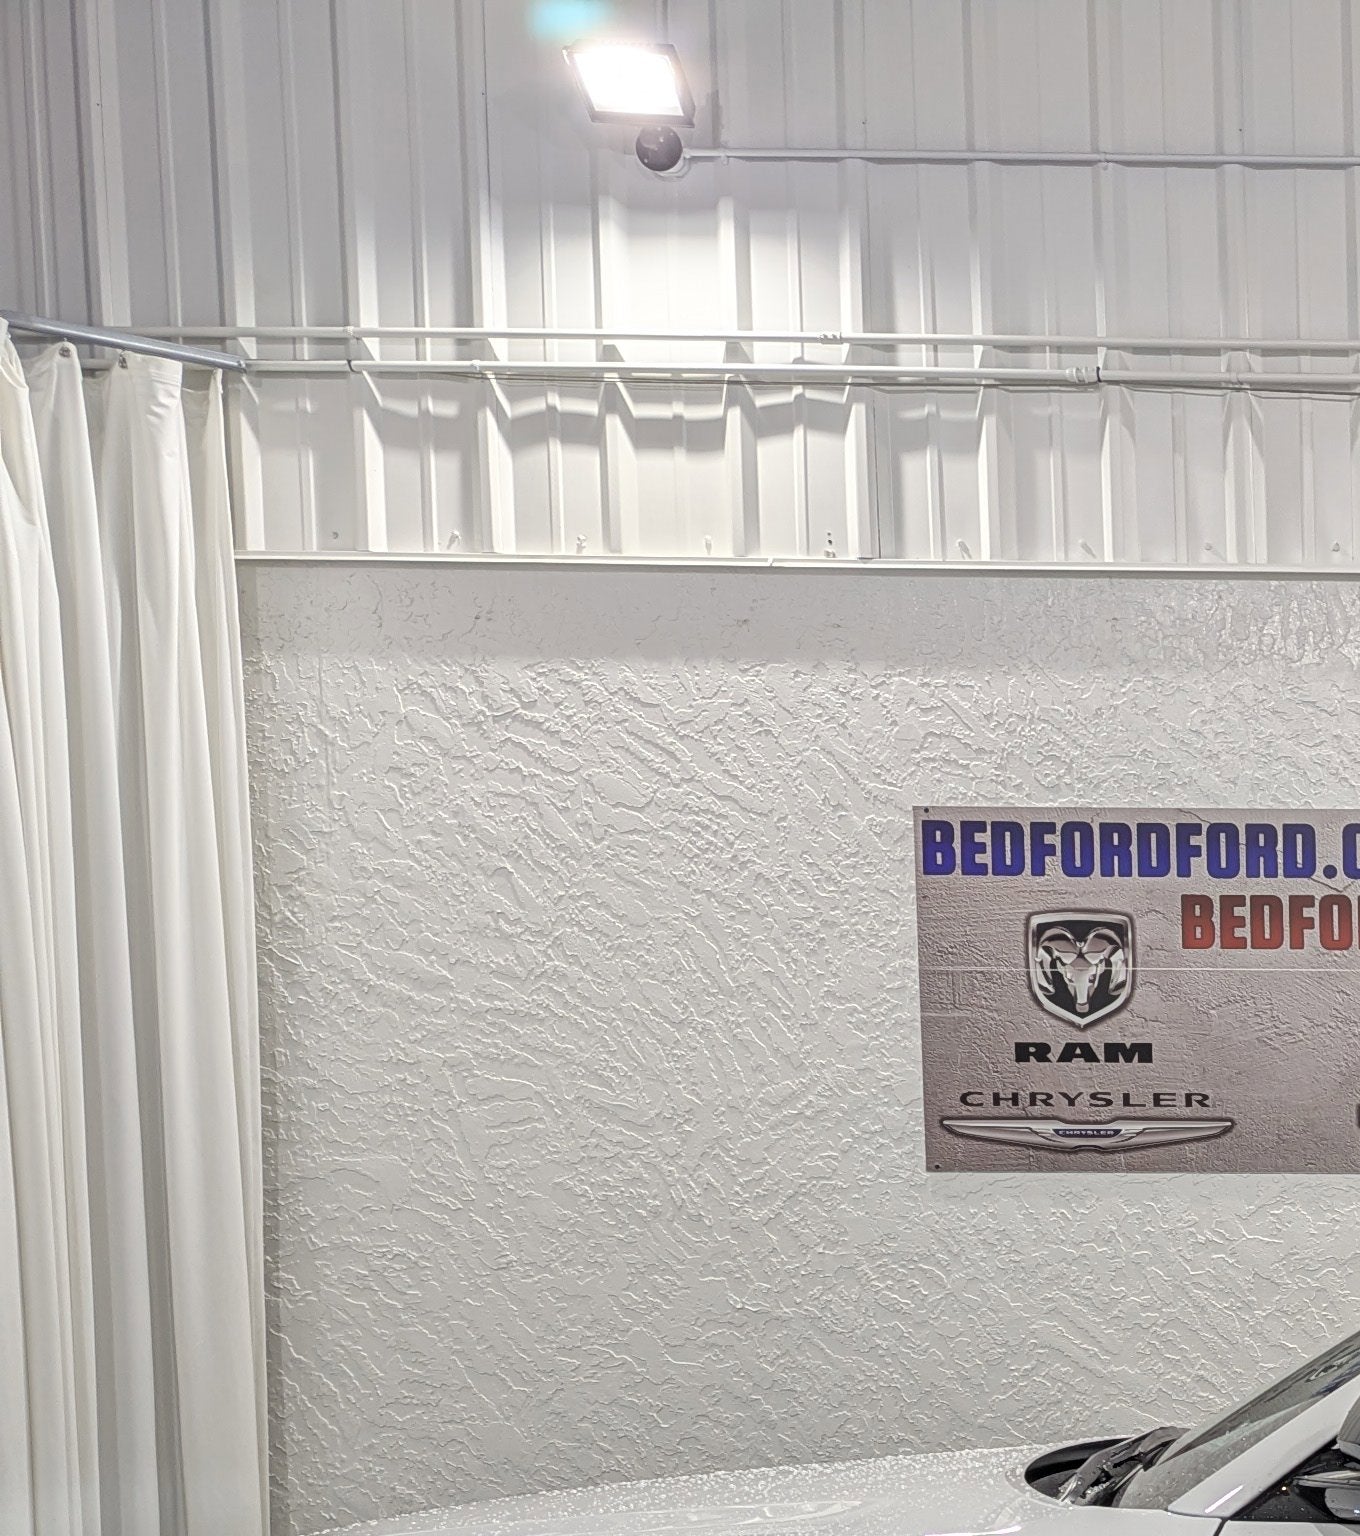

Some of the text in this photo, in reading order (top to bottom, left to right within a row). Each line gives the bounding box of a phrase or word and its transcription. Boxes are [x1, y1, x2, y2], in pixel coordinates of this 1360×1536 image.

[1014, 1042, 1153, 1064] RAM
[959, 1091, 1211, 1108] CHRYSLER
[1058, 1129, 1115, 1137] CHRYSLER
